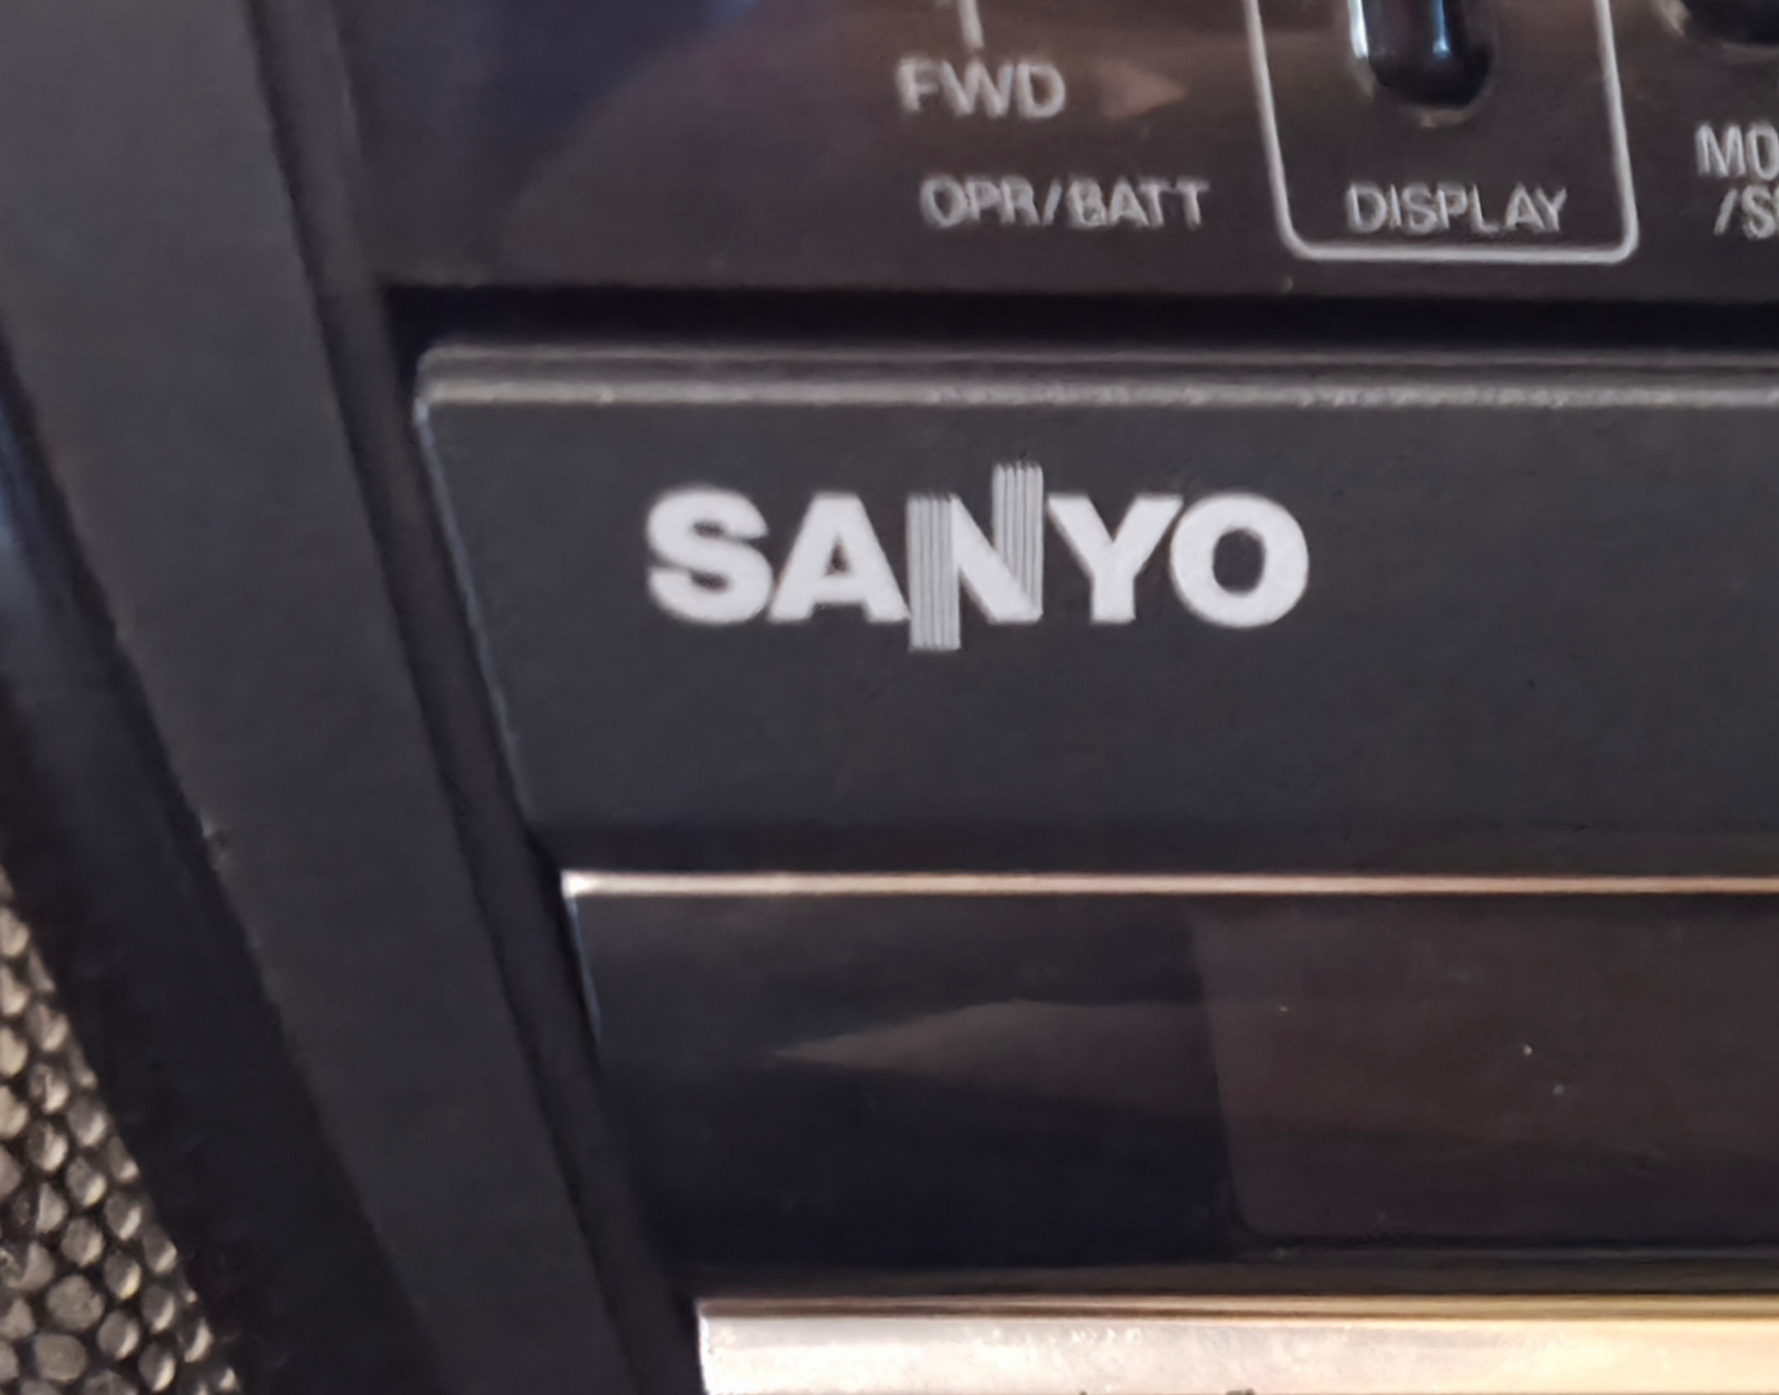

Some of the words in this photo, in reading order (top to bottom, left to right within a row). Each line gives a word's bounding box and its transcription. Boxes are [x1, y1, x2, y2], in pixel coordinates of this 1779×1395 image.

[897, 57, 1066, 118] FWD
[921, 176, 1207, 228] OPR/BATT
[1346, 183, 1566, 233] DISPLAY
[647, 465, 1309, 650] SANYO
